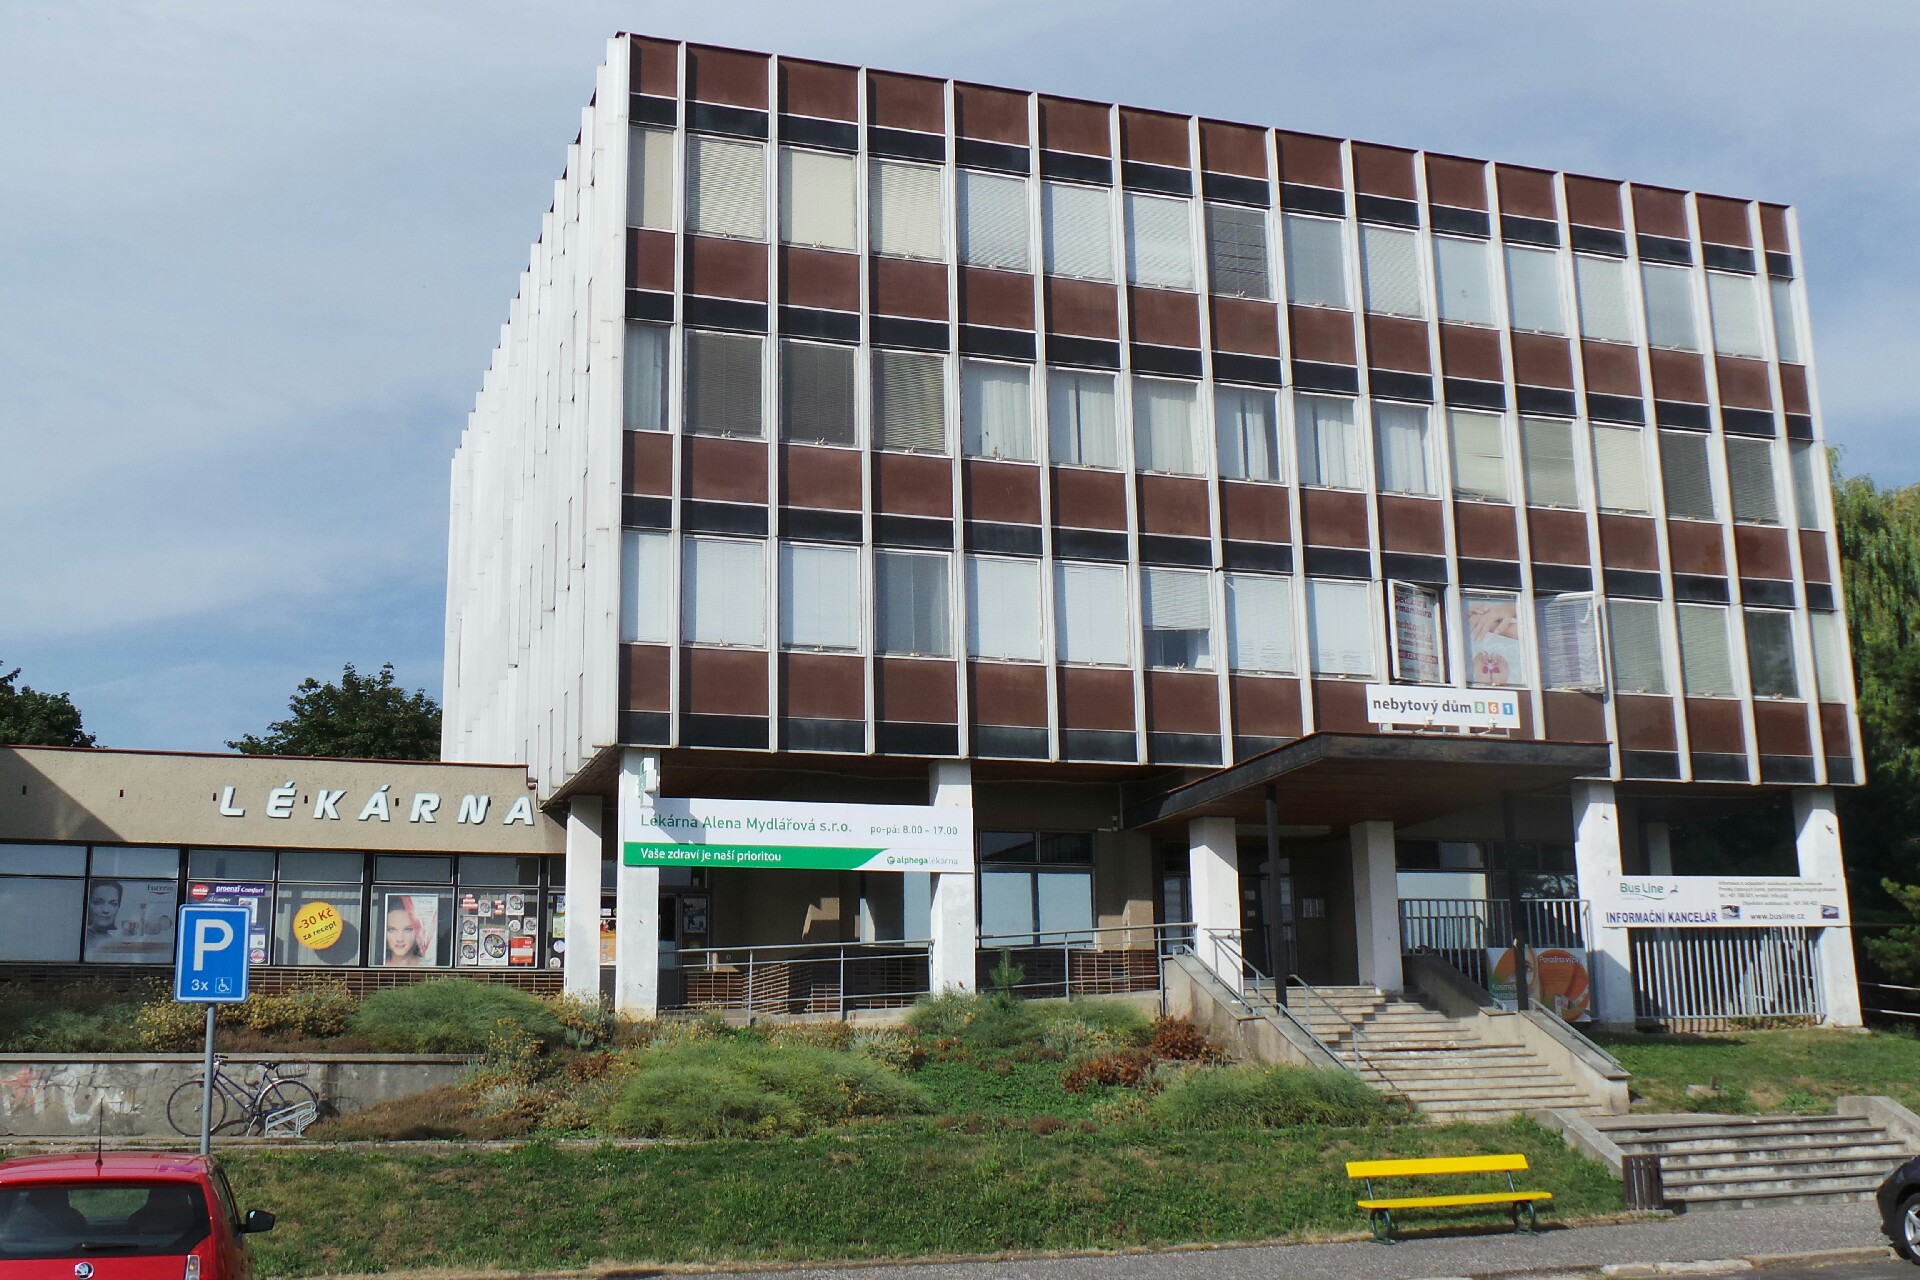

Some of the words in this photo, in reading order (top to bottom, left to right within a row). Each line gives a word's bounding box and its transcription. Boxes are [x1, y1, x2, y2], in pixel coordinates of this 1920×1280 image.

[1373, 697, 1438, 714] nebytový
[1442, 700, 1472, 713] dům
[219, 780, 534, 825] LÉKÁRNA
[640, 814, 698, 828] Lékárna
[702, 816, 742, 829] Alena
[746, 817, 816, 832] Mydlářová
[819, 821, 852, 832] s.r.o.
[870, 825, 900, 835] po-pá:
[902, 825, 923, 834] 8.00
[933, 826, 958, 834] 17.00
[640, 848, 665, 859] Vaše
[667, 848, 700, 859] zdraví
[701, 850, 711, 862] je
[713, 850, 735, 860] naší
[737, 851, 782, 862] prioritou
[896, 855, 928, 865] alphega
[216, 885, 240, 893] proenzi
[298, 915, 317, 929] -30
[317, 907, 334, 921] Kč
[1606, 909, 1665, 923] INFORMAČNÍ
[1668, 909, 1718, 923] KANCELÁŘ
[312, 920, 337, 936] recept
[193, 918, 234, 972] P
[191, 978, 209, 991] 3x
